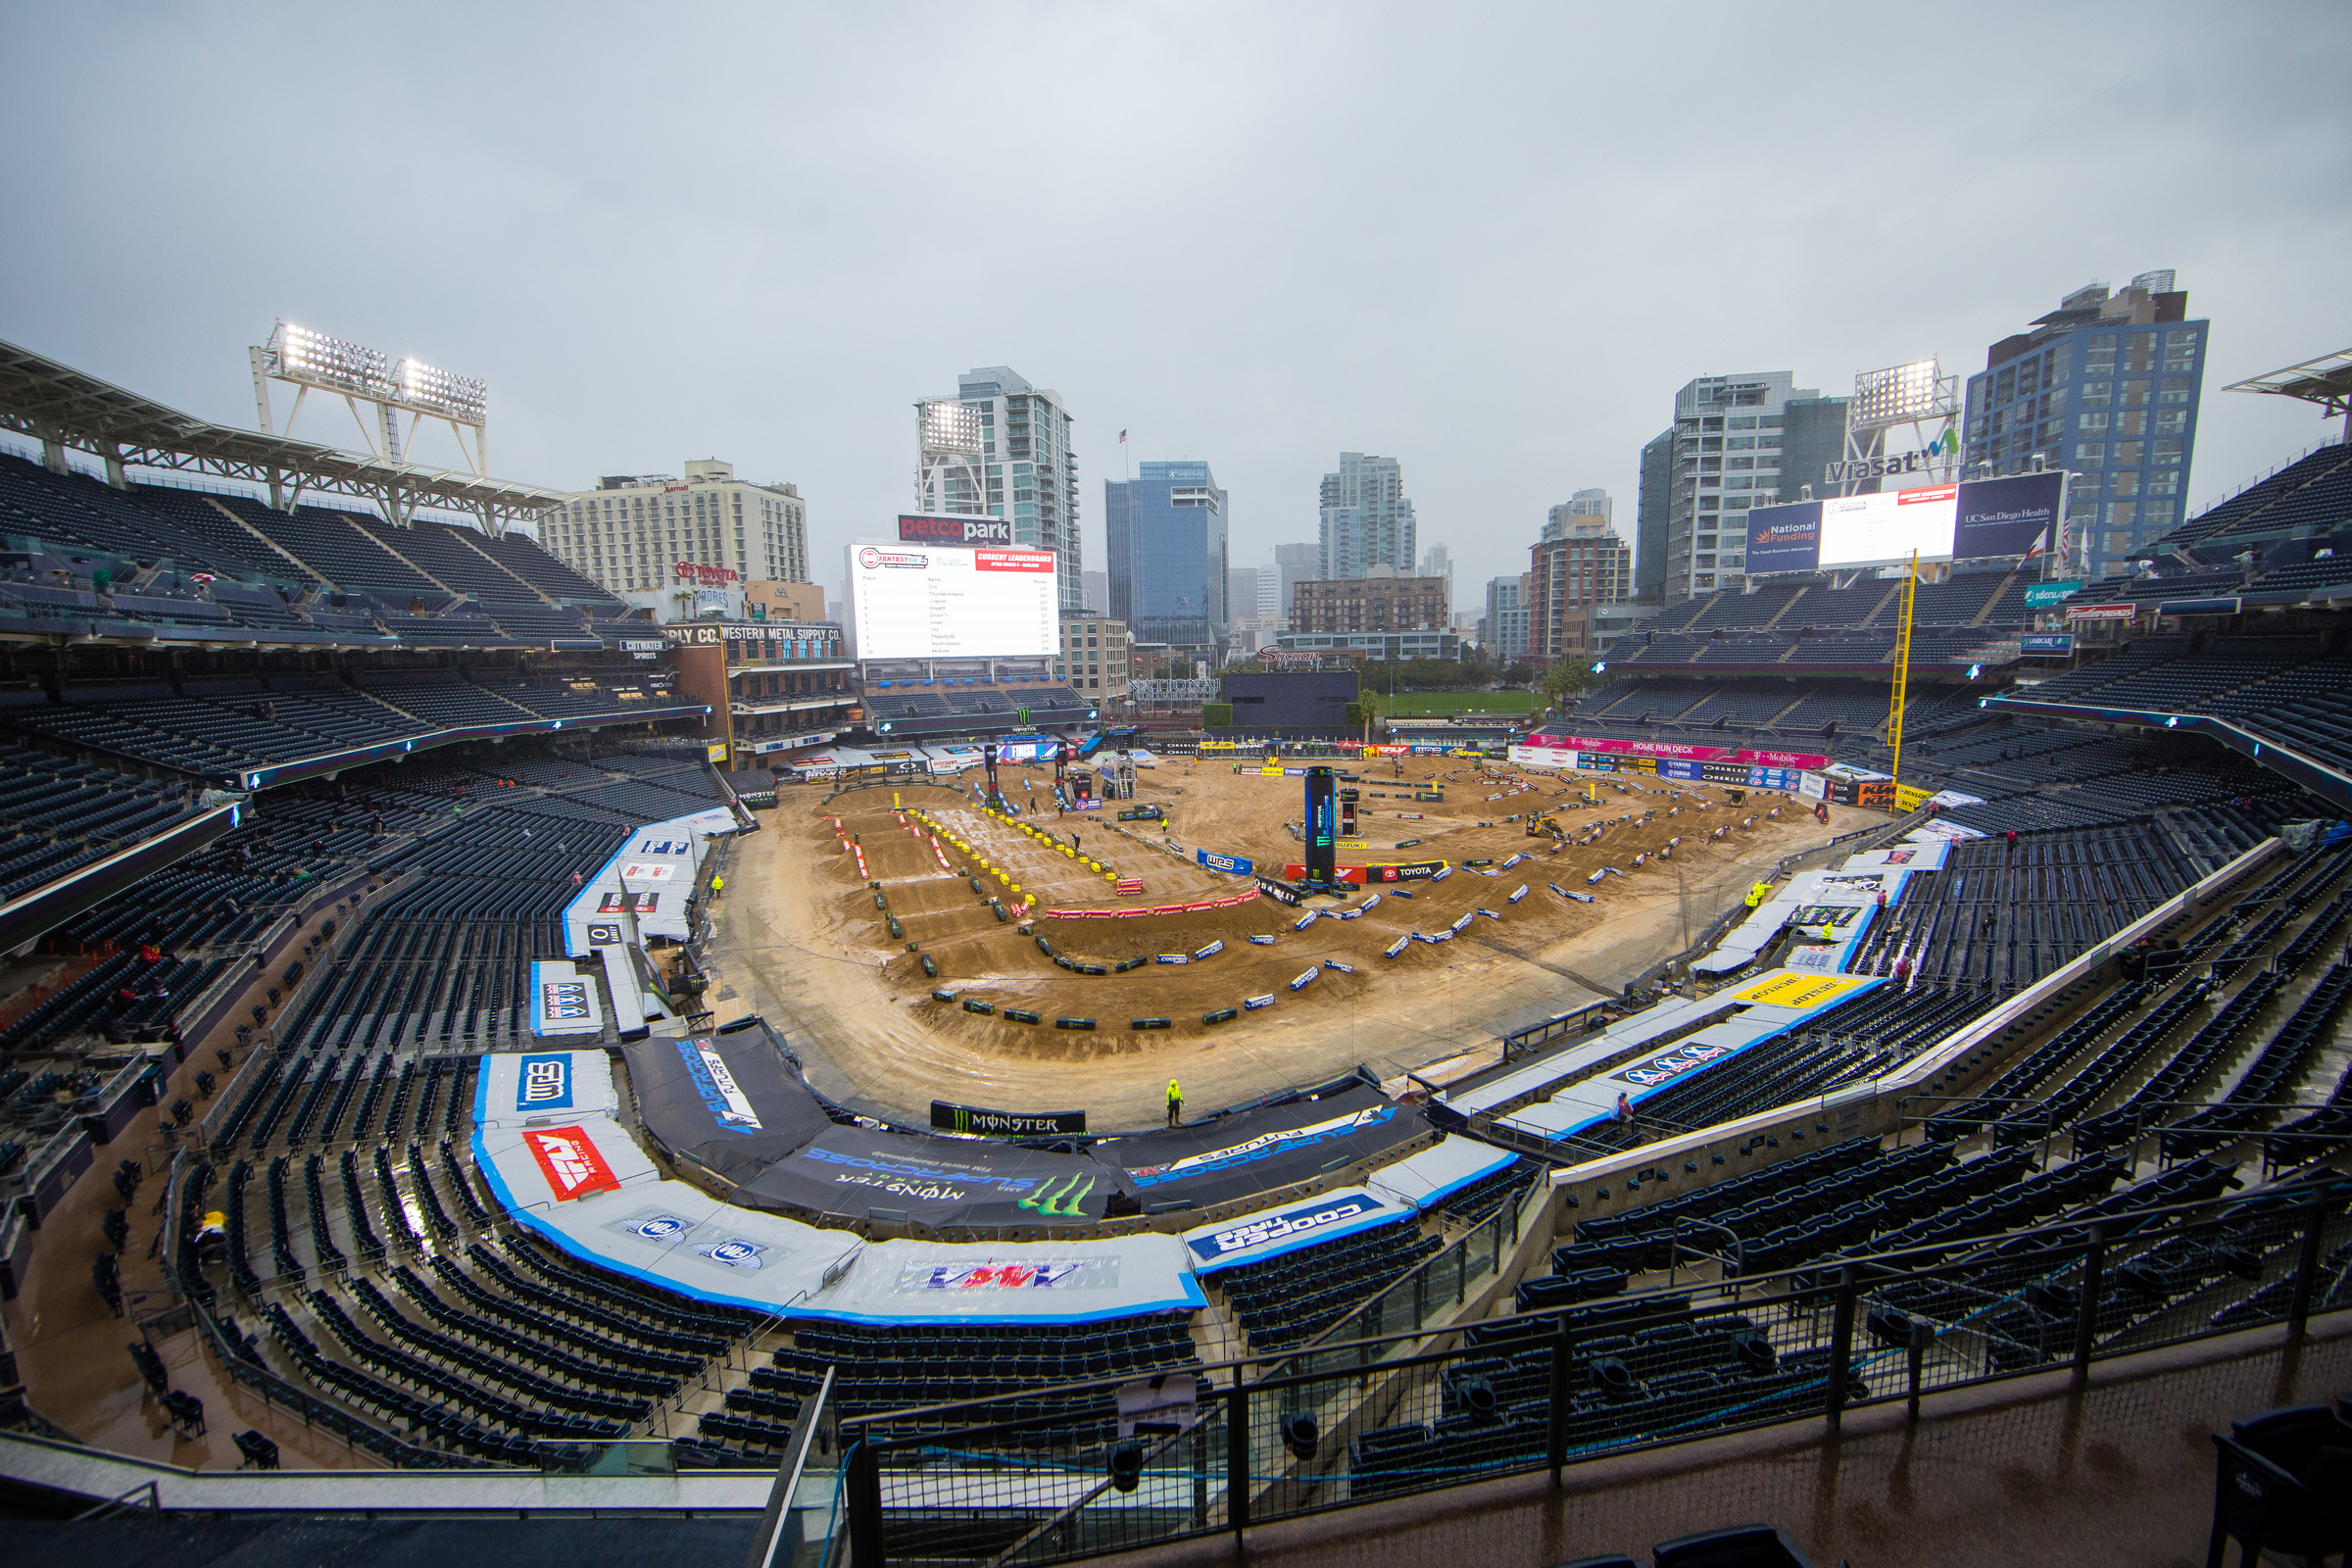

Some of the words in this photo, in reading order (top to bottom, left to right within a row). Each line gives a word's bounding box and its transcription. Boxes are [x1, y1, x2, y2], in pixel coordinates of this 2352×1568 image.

[1829, 451, 1914, 482] Viasat
[1965, 514, 1979, 523] UC
[1980, 513, 1995, 521] San
[1997, 512, 2021, 521] Diego
[2022, 508, 2050, 517] Health
[1771, 521, 1816, 534] National
[1770, 531, 1815, 542] Funding
[695, 565, 739, 581] TOYOTA
[695, 590, 729, 608] PADRES
[697, 628, 720, 643] CO.
[721, 626, 764, 640] WESTERN
[767, 627, 796, 640] METAL
[797, 628, 825, 640] SUPPLY
[829, 629, 841, 641] CO.
[1257, 644, 1322, 666] Sycuan
[1127, 678, 1222, 692] NATIONAL
[1011, 744, 1036, 757] FINISH
[1633, 743, 1655, 752] HOME
[1656, 744, 1672, 753] RUN
[739, 790, 776, 800] MONSTER
[1863, 786, 1897, 795] KTM
[1903, 790, 1928, 800] DUNLOP
[1862, 797, 1896, 806] KTM
[1206, 855, 1234, 870] WPS
[1399, 866, 1433, 876] TOYOTA
[1199, 943, 1223, 957] COOPER
[1750, 978, 1798, 1001] DUNLOP
[1791, 982, 1838, 1005] DUNLOP
[1251, 998, 1275, 1006] COOPER
[525, 1061, 564, 1102] WPS
[675, 1040, 729, 1112] SUPERCROSS
[707, 1058, 738, 1094] FUTURES
[972, 1113, 1058, 1132] MONSTER
[1198, 1129, 1305, 1161] FUTURES
[536, 1134, 589, 1192] FLY
[570, 1140, 598, 1174] RACING
[871, 1150, 940, 1167] Championship
[1134, 1126, 1357, 1189] SUPERCROSS
[803, 1148, 1042, 1189] SUPERCROSS
[976, 1163, 992, 1172] FIM
[1123, 1162, 1172, 1178] AMA
[861, 1171, 953, 1185] ENERGY
[835, 1173, 965, 1201] MONSTER
[646, 1221, 676, 1234] FIM
[1215, 1203, 1362, 1252] COOPER
[1215, 1215, 1294, 1242] TIRES
[714, 1244, 750, 1257] FIM
